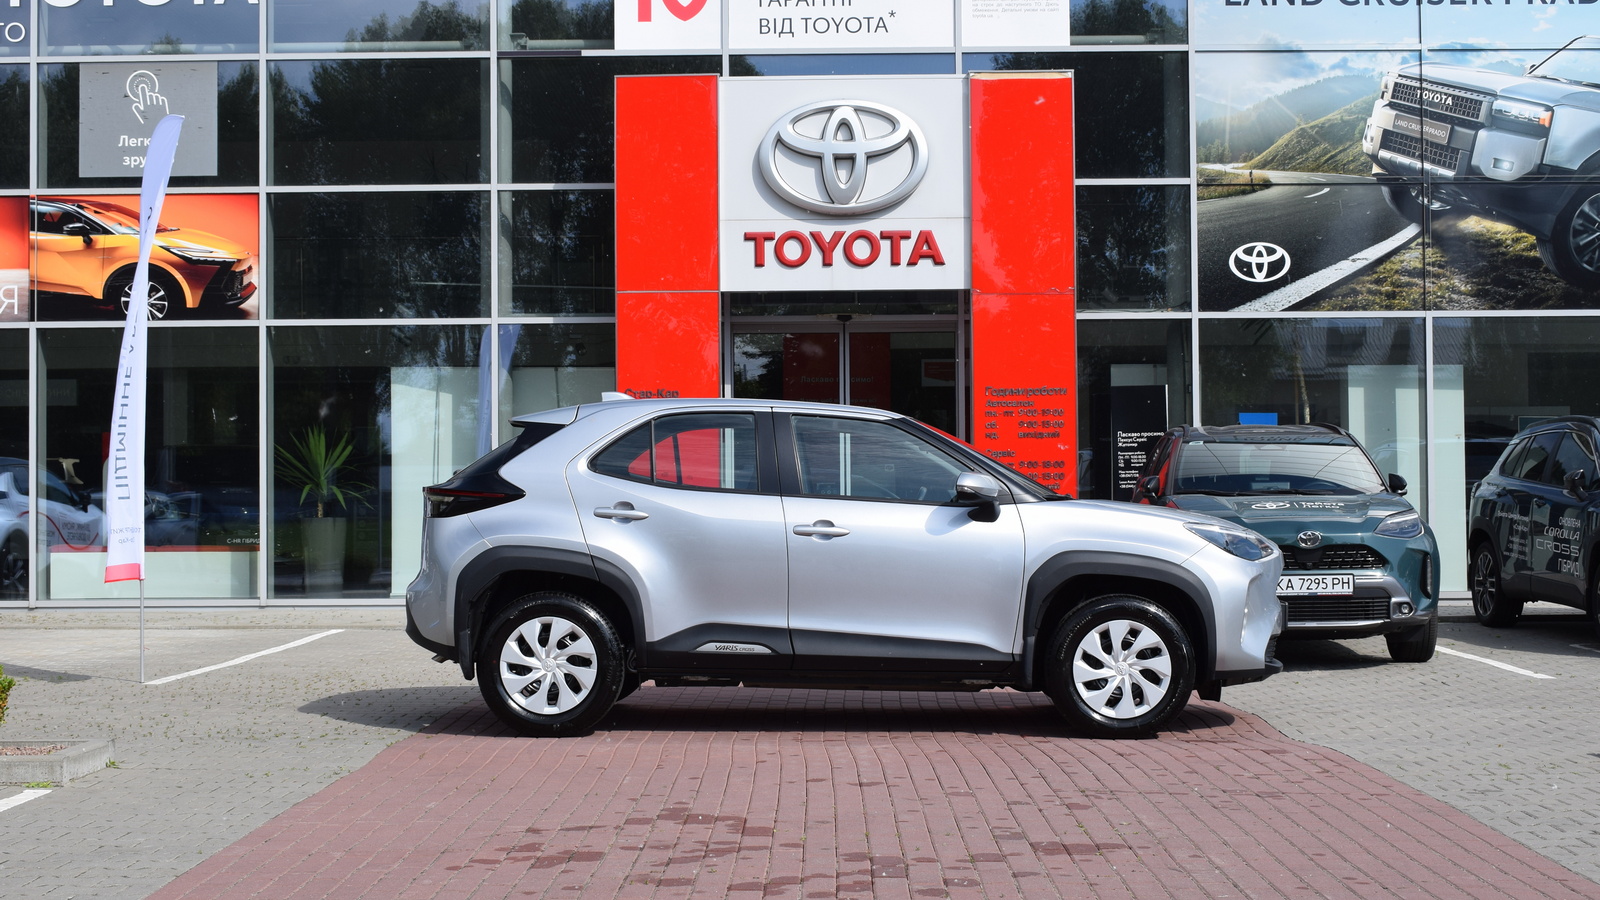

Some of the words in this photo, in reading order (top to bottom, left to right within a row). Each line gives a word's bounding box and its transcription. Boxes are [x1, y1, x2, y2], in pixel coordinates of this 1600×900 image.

[759, 18, 794, 38] ВІД
[1394, 119, 1408, 128] LAND
[1429, 127, 1447, 138] PRADO
[118, 135, 154, 147] Легк
[744, 230, 946, 267] TOYOTA
[985, 386, 1025, 397] Години
[1026, 386, 1067, 398] роботи
[985, 399, 1034, 407] Автосалон
[1018, 408, 1064, 416] 9:00-19:00
[1018, 430, 1060, 439] вихідний
[1543, 525, 1580, 541] COROLLA
[1535, 538, 1580, 557] CROSS
[1299, 577, 1328, 590] 7295
